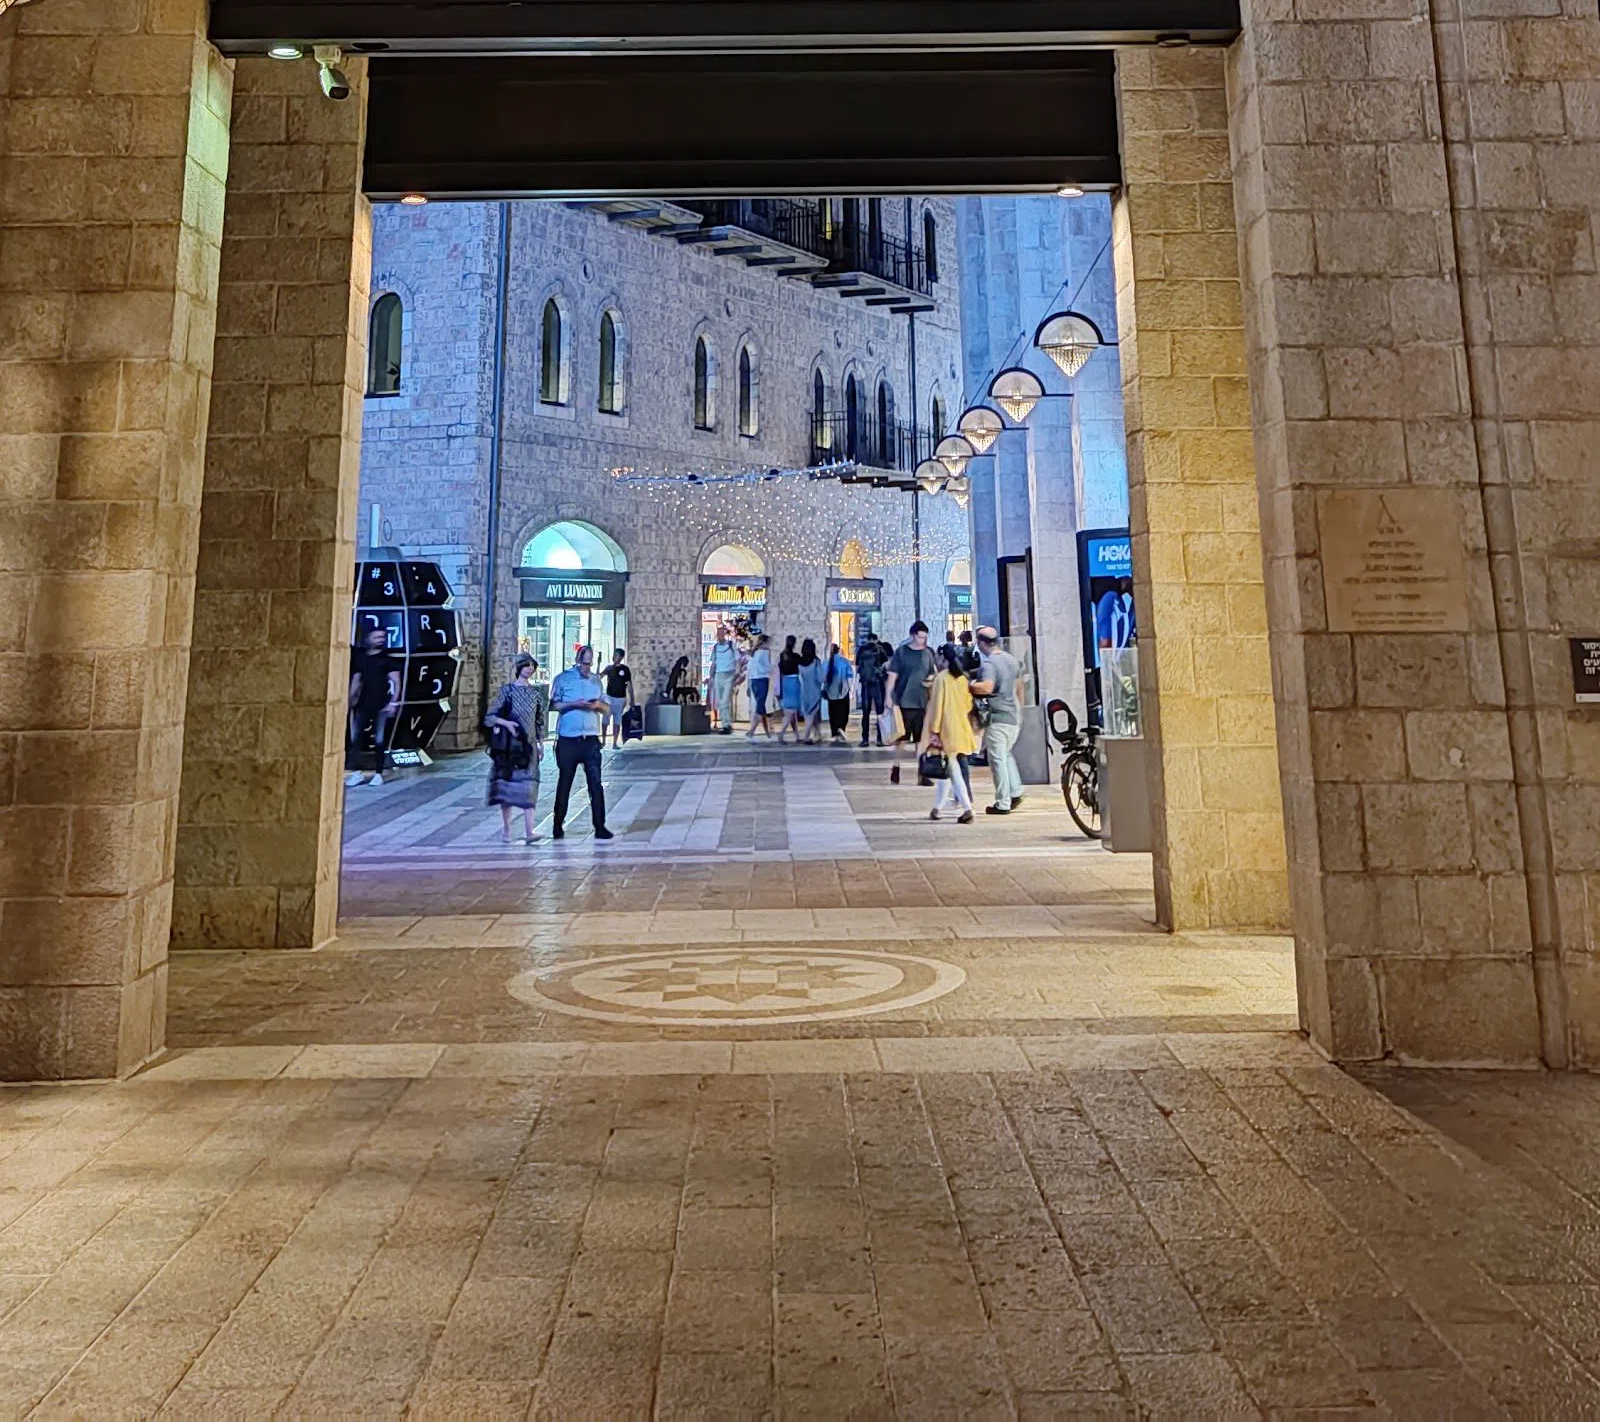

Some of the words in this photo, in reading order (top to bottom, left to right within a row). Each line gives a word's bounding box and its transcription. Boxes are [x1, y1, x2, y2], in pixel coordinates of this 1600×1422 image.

[384, 581, 395, 596] 3
[427, 581, 436, 595] 4
[546, 584, 562, 598] AVI
[708, 584, 742, 604] Mamilla
[420, 614, 431, 630] R
[419, 665, 428, 682] F
